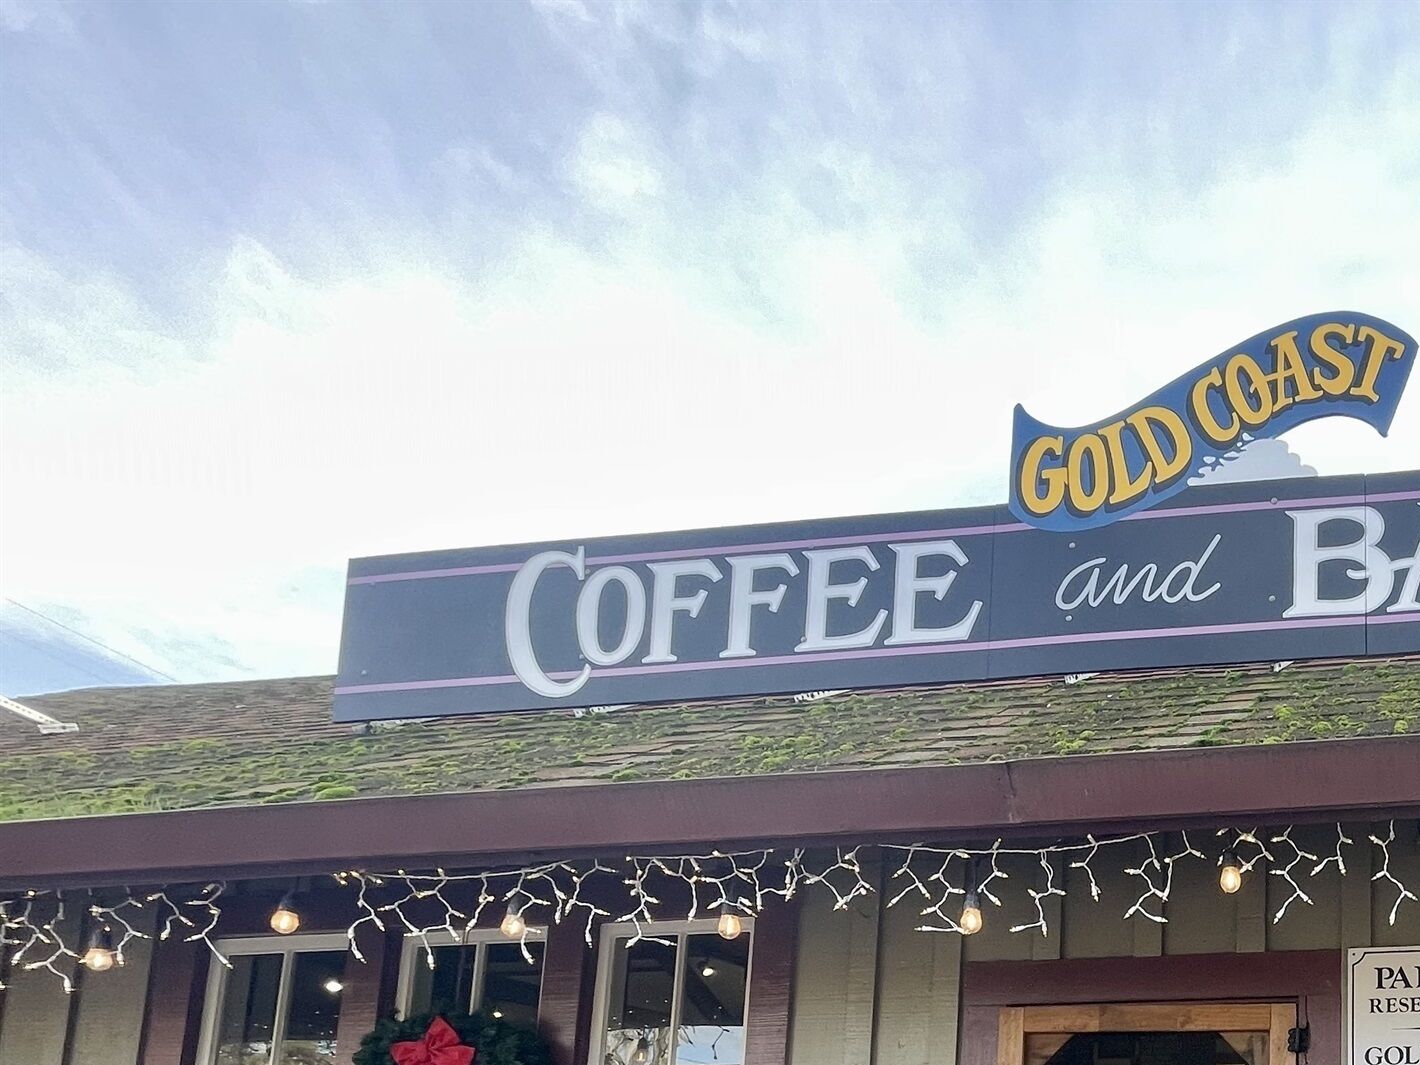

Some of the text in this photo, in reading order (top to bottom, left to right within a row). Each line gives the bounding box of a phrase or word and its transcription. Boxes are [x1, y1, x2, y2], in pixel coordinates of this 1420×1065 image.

[1020, 322, 1405, 514] GOLD COAST
[504, 538, 983, 699] COFFEE
[1055, 534, 1222, 609] and
